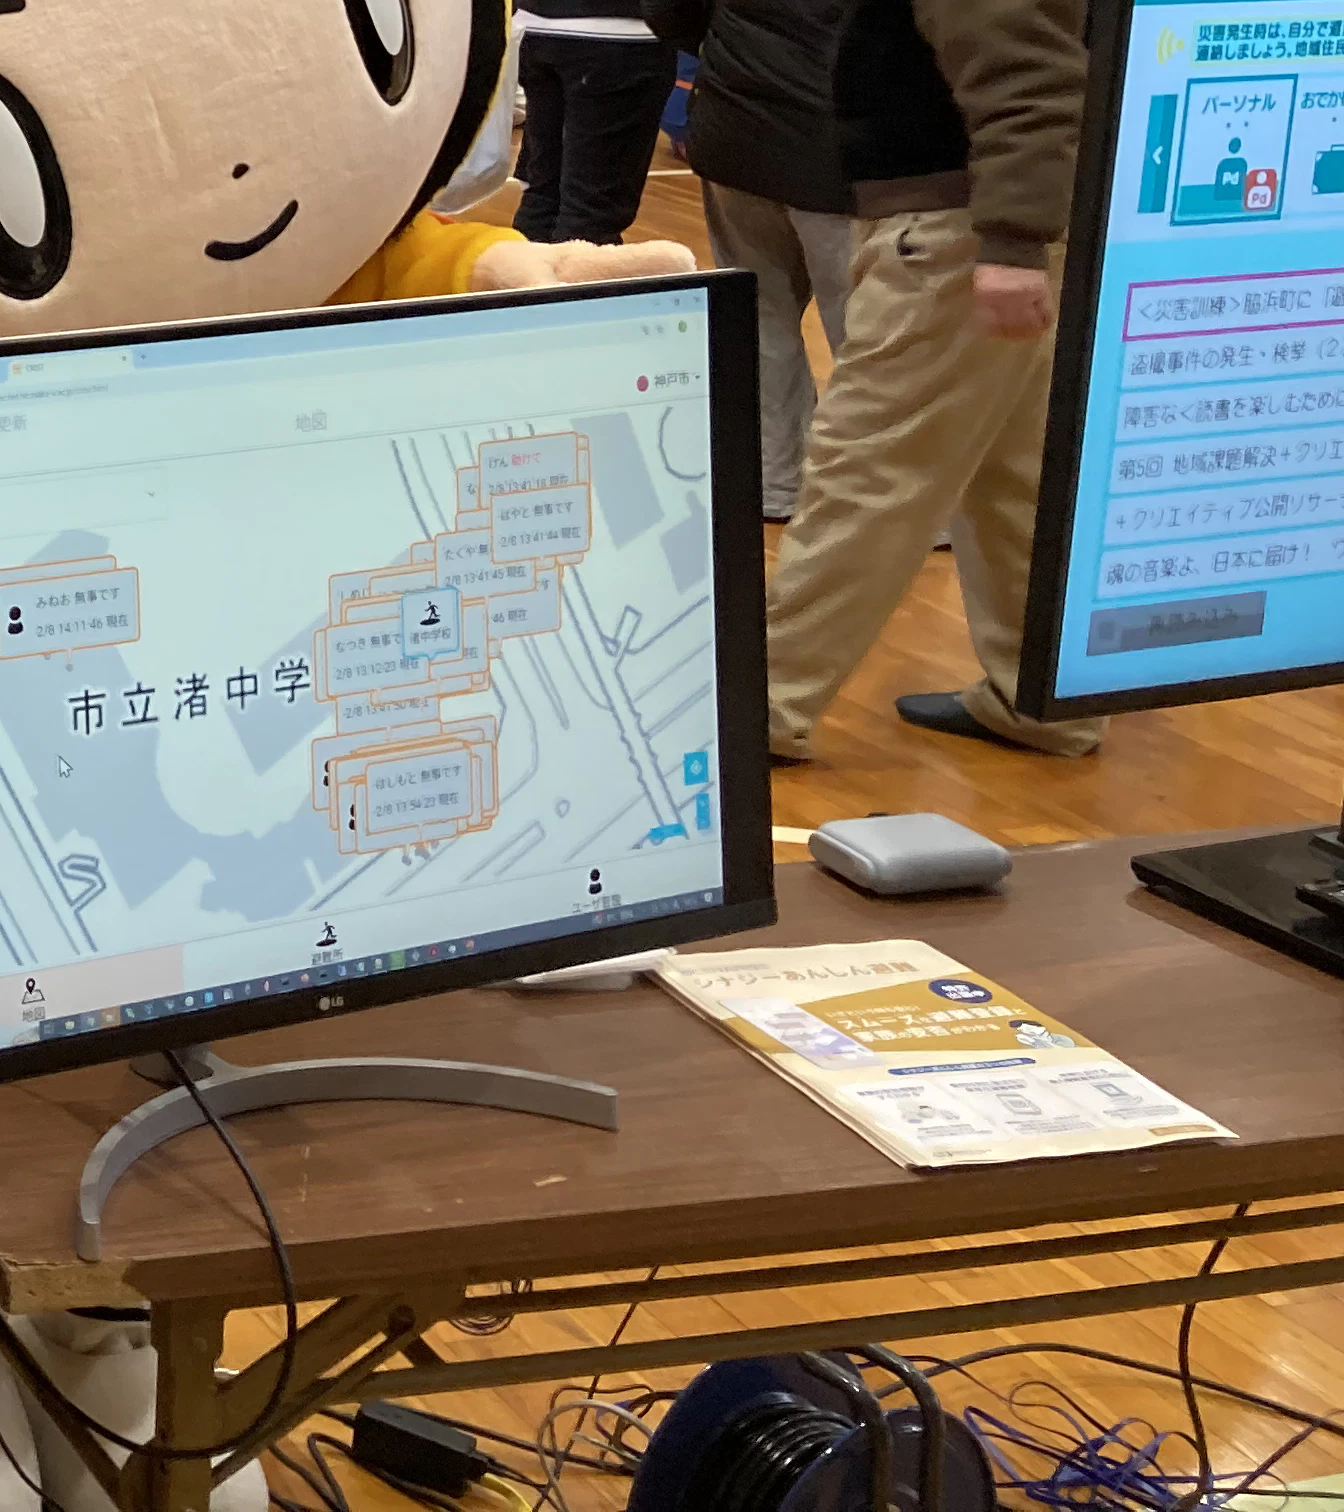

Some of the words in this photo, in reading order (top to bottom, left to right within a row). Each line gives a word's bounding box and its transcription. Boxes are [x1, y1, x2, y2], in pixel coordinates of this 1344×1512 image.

[1201, 92, 1277, 115] パーソナル
[1115, 493, 1344, 531] ＋クリエイティブ公開リサー
[67, 656, 311, 737] 市立渚中学
